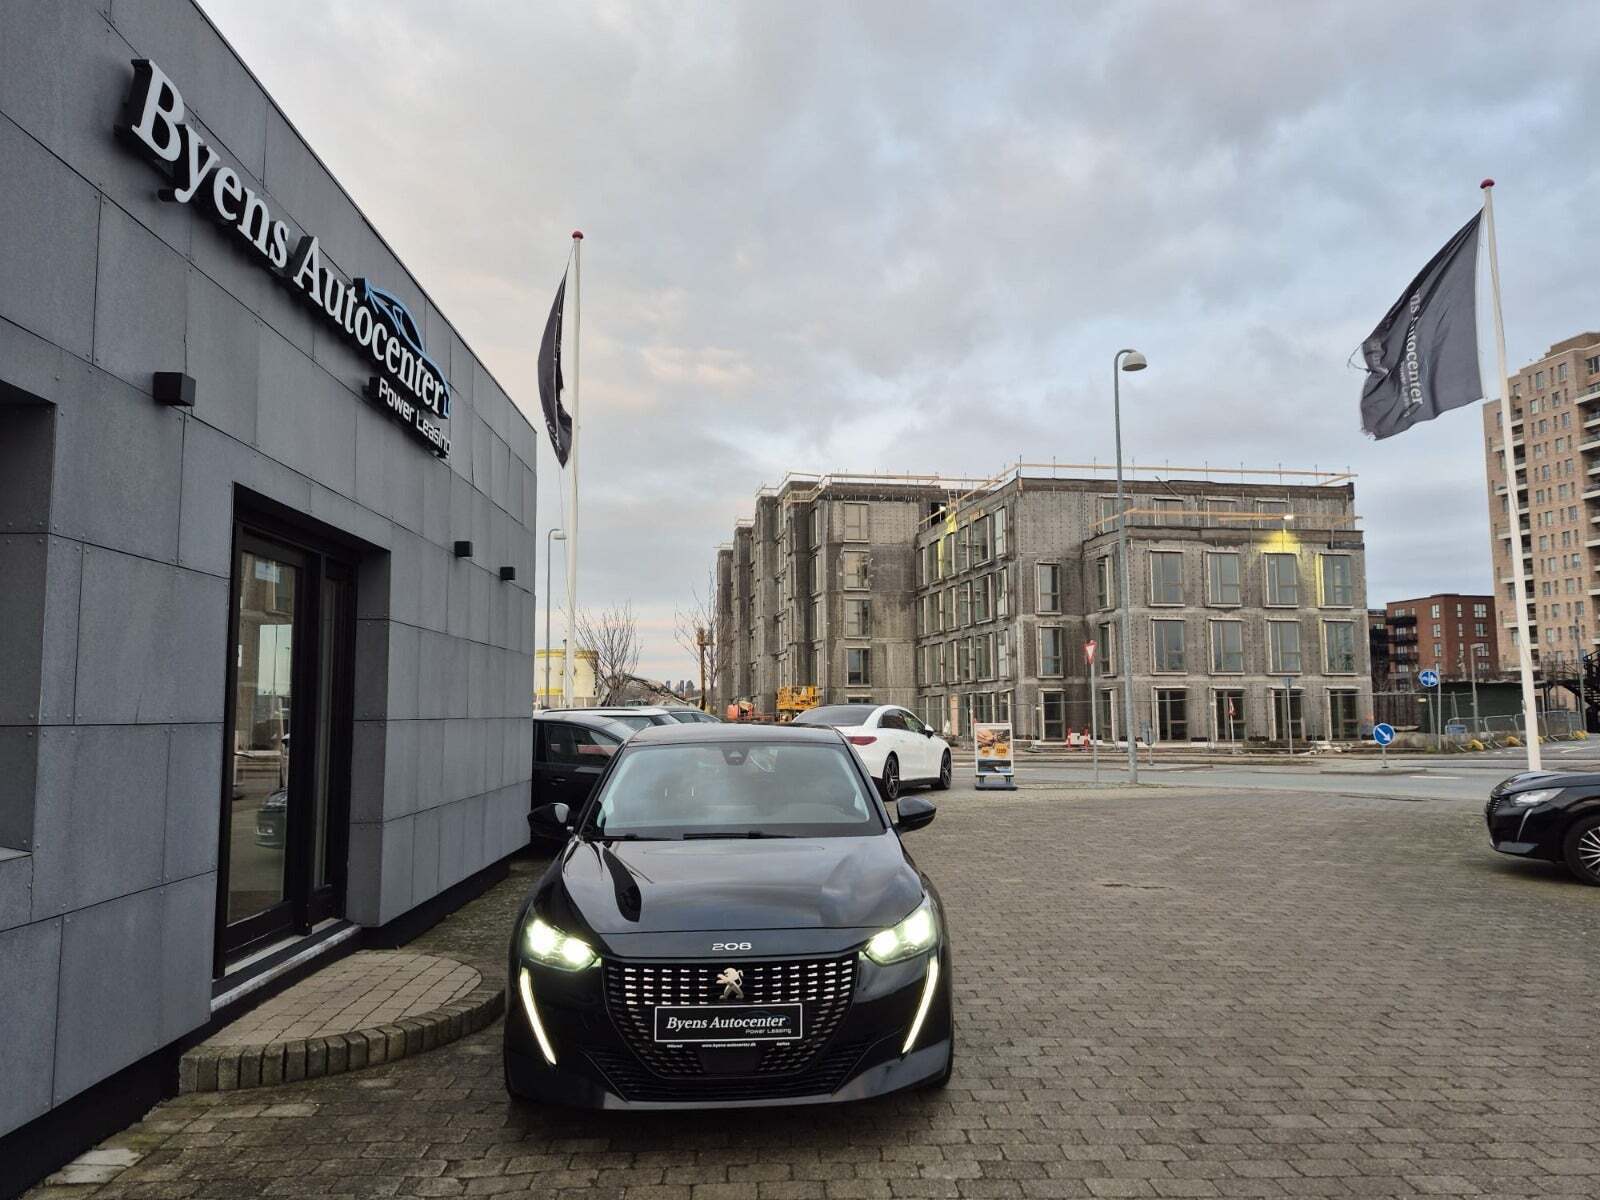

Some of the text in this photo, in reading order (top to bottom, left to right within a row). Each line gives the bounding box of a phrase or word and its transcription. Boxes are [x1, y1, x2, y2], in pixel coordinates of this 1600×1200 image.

[131, 59, 444, 415] Byens Autocenter
[378, 377, 452, 460] Power Leasing
[712, 942, 752, 951] 208
[666, 1015, 787, 1032] Byens Autocenter
